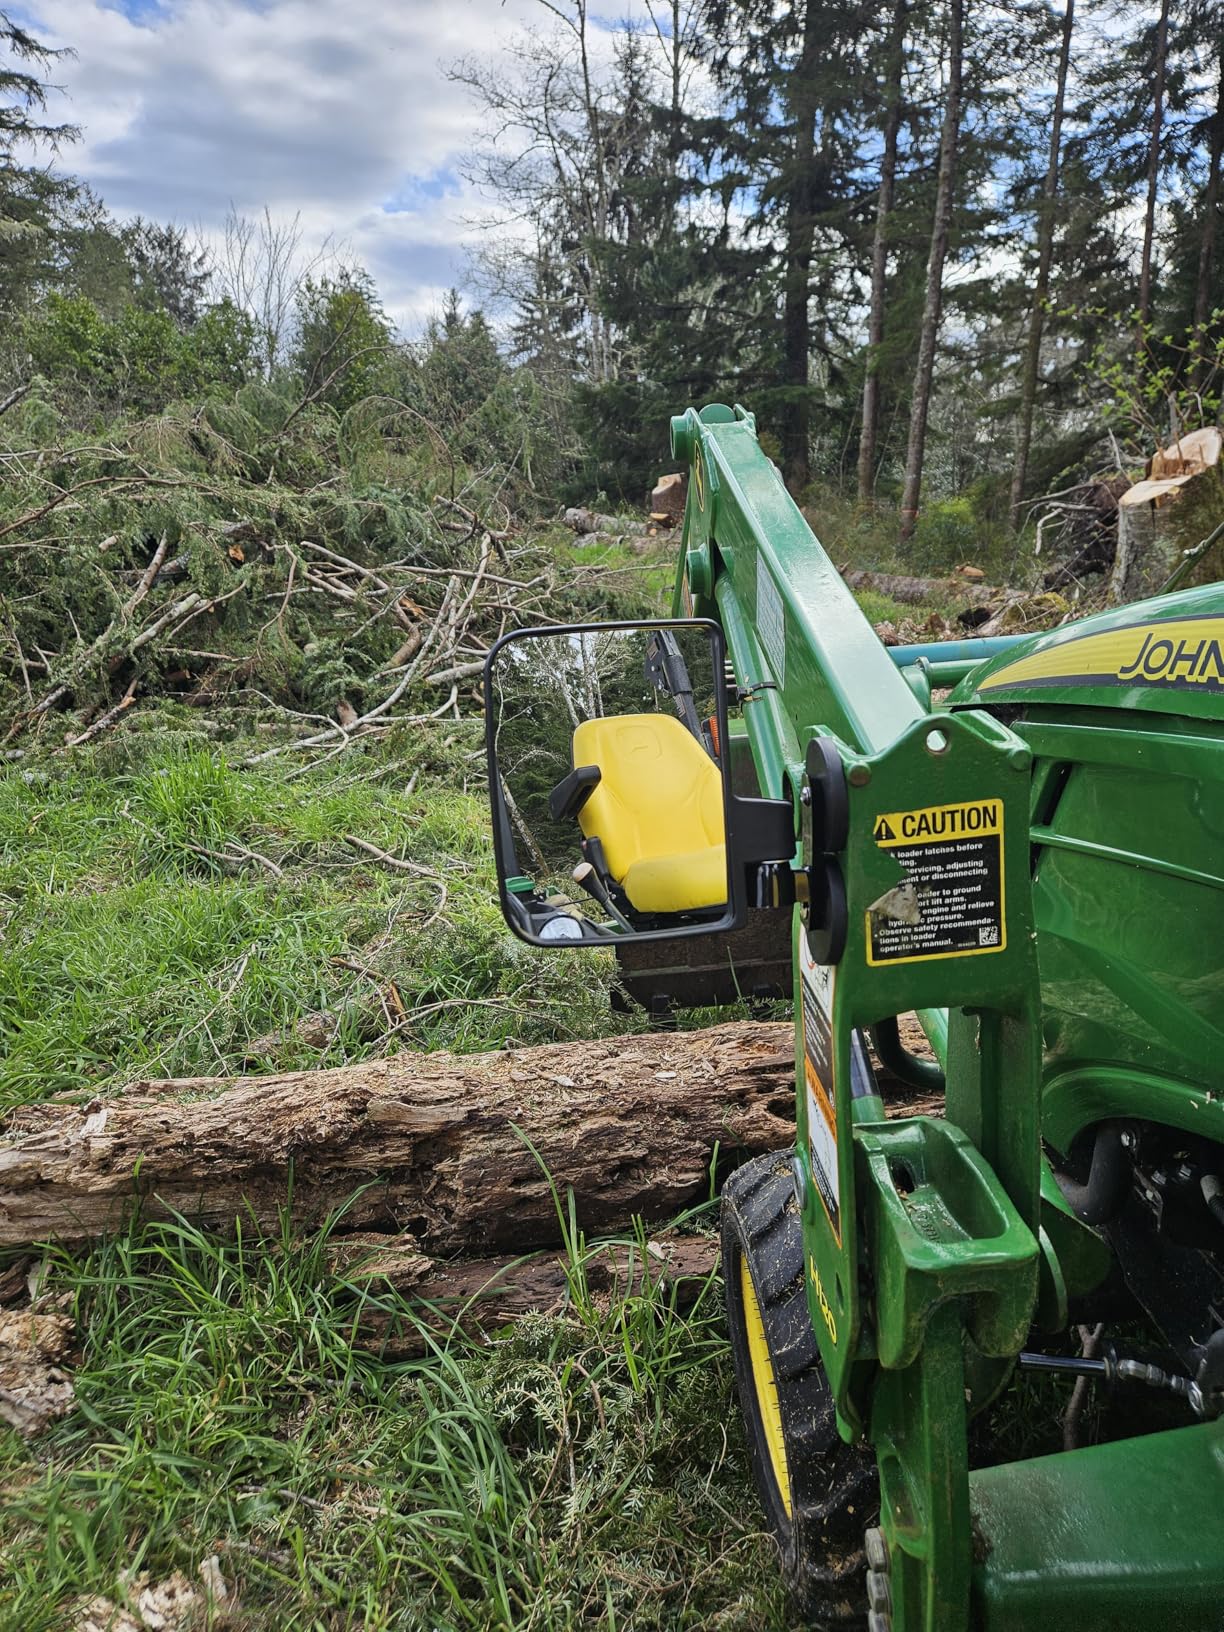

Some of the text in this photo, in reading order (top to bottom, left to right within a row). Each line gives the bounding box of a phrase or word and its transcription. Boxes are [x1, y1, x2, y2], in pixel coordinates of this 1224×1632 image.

[902, 804, 997, 838] CAUTION
[897, 843, 983, 858] loader latches before
[946, 860, 984, 871] adjusting
[931, 868, 988, 880] disconnecting
[917, 884, 982, 899] oader to ground
[922, 900, 995, 915] engine and relieve
[931, 897, 943, 906] lift
[944, 895, 967, 904] arms.
[879, 916, 995, 936] Observe safety recommenda-
[926, 913, 965, 924] pressure.
[880, 936, 900, 945] tions
[911, 932, 937, 941] loader
[880, 942, 921, 953] operator's
[922, 937, 954, 948] manual.
